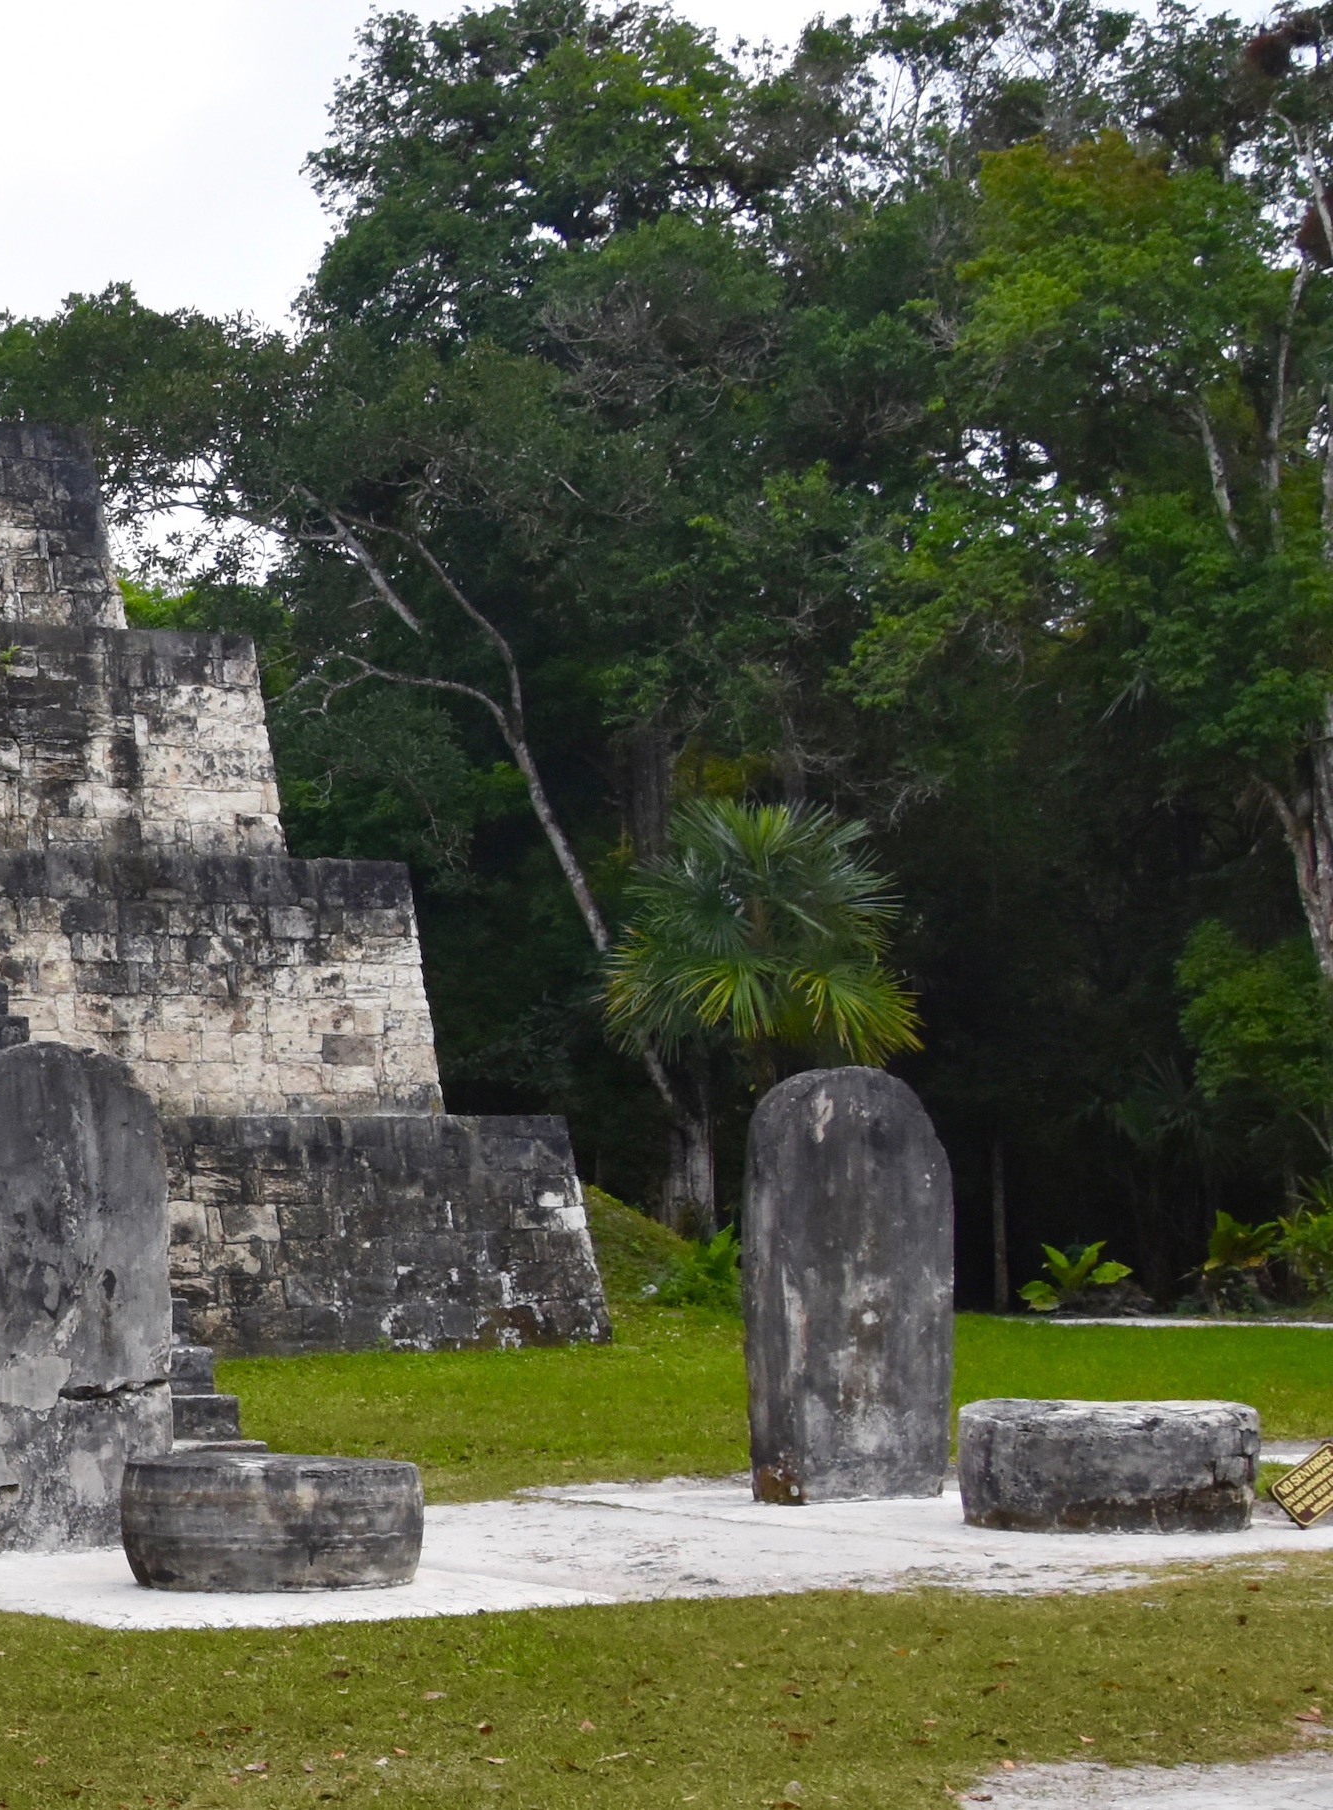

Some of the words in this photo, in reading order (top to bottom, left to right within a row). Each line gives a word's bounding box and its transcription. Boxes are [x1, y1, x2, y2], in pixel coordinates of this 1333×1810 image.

[1277, 1480, 1294, 1496] NO
[1290, 1449, 1333, 1486] SENTARSE
[1303, 1463, 1333, 1491] MONUMEN
[1293, 1502, 1305, 1514] DO
[1302, 1493, 1317, 1507] NOT
